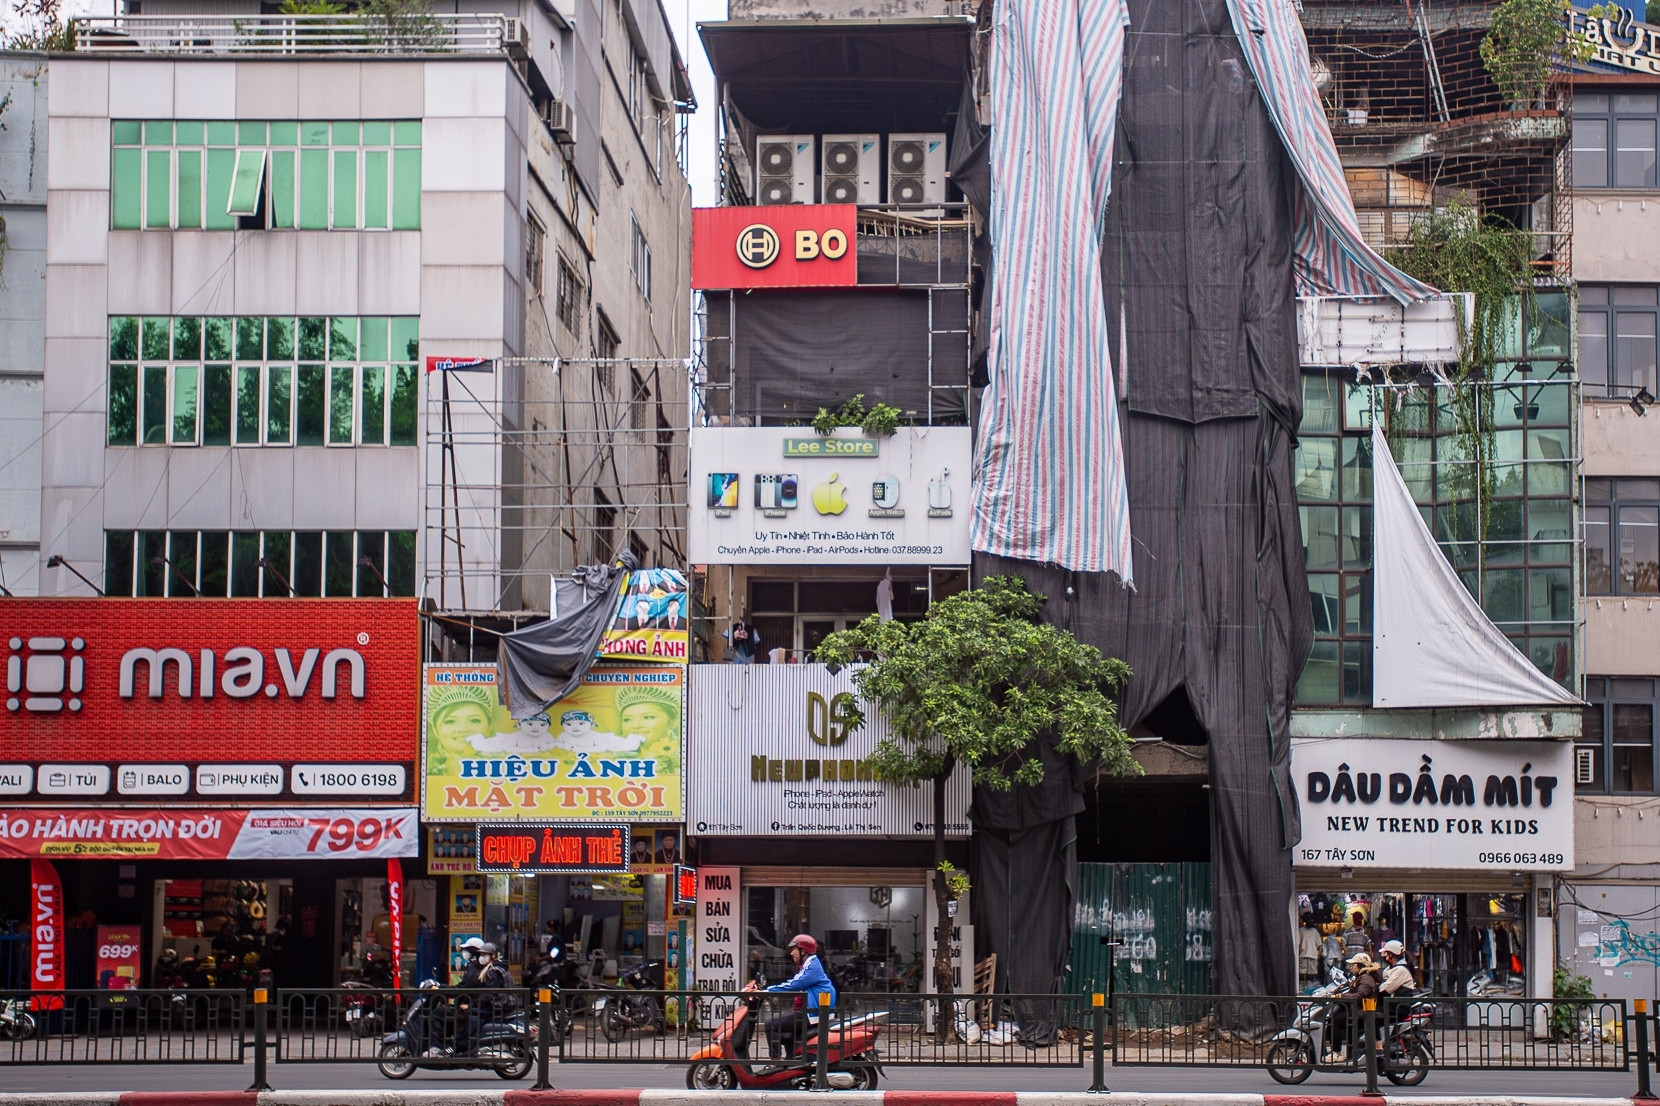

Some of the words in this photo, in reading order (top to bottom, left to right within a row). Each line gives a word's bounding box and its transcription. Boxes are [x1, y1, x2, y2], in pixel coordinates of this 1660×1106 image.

[795, 228, 848, 261] BO
[788, 441, 819, 453] Lee
[825, 440, 874, 453] Store
[755, 532, 768, 542] Uy
[789, 531, 810, 542] Nhiệt
[857, 531, 878, 540] Hành
[748, 545, 770, 555] Apple
[776, 545, 801, 554] iPhone
[807, 545, 823, 554] iPad
[828, 545, 859, 554] AirPods
[892, 545, 943, 554] 037.88999.23
[652, 634, 686, 657] ẢNH
[118, 646, 366, 698] mia.vn
[436, 671, 452, 685] HỆ
[455, 669, 495, 683] THỐNG
[585, 671, 630, 683] CHUYÊN
[634, 671, 677, 685] NGHIỆP
[460, 755, 557, 782] HIỆU
[568, 753, 656, 778] ẢNH
[147, 774, 182, 786] BALO
[222, 774, 248, 788] PHỤ
[250, 772, 279, 787] KIỆN
[319, 774, 357, 787] 1800
[360, 774, 398, 787] 6198
[1308, 762, 1382, 804] DÂU
[1389, 753, 1476, 806] DẦM
[1484, 762, 1558, 808] MÍT
[444, 780, 545, 813] MẶT
[556, 780, 665, 808] TRỜI
[32, 814, 105, 839] HÀNH
[109, 819, 174, 842] TRỌN
[178, 814, 222, 840] ĐỜI
[1327, 816, 1369, 832] NEW
[1376, 817, 1439, 833] TREND
[1446, 818, 1484, 834] FOR
[1491, 819, 1539, 835] KIDS
[306, 817, 406, 853] 799K
[483, 835, 536, 868] CHỤP
[540, 827, 582, 864] ẢNH
[586, 828, 623, 865] THẺ
[1301, 849, 1321, 860] 167
[1325, 847, 1347, 861] TÂY
[1350, 849, 1375, 861] SƠN
[1479, 852, 1512, 864] 0966
[1514, 852, 1537, 864] 063
[1539, 853, 1564, 864] 489
[705, 875, 732, 890] MUA
[706, 898, 730, 916] BÁN
[706, 921, 730, 943] SỬA
